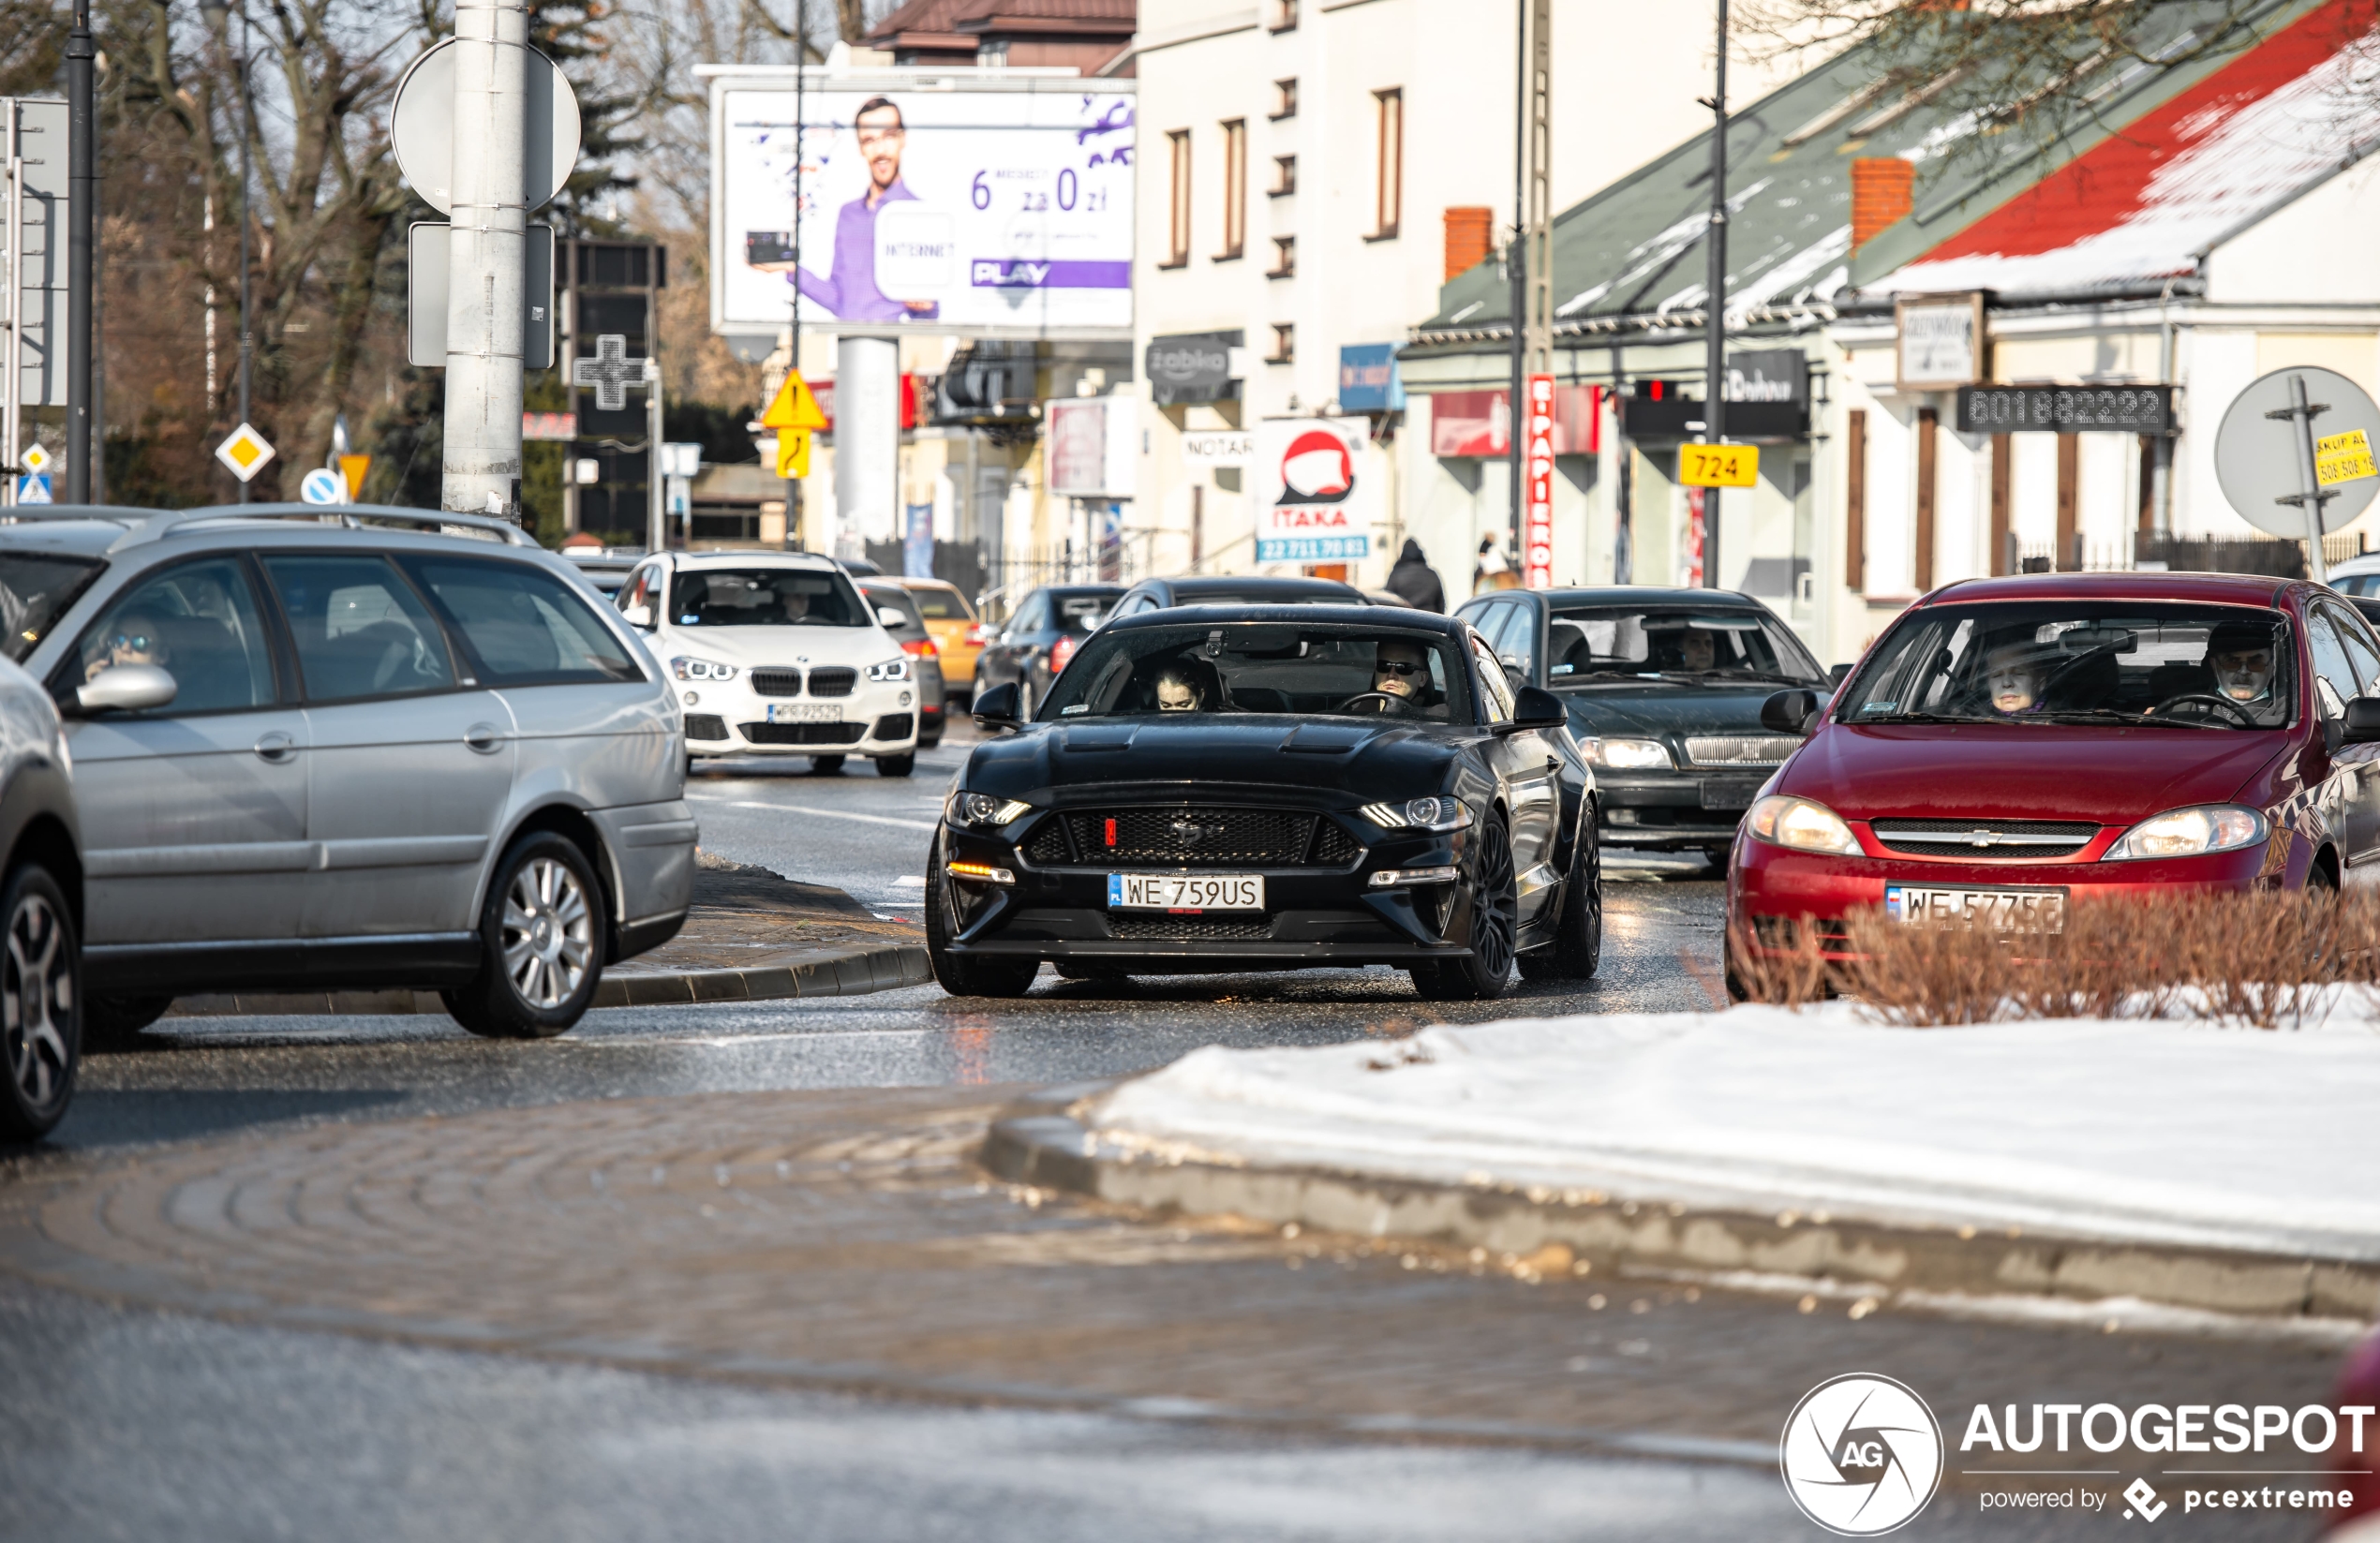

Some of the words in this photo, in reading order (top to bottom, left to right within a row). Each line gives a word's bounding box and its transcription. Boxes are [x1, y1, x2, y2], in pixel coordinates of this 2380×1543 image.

[973, 169, 990, 211] 6
[974, 261, 1051, 284] PLAY
[1695, 454, 1738, 479] 724
[1272, 510, 1347, 527] ITAKA
[1111, 893, 1121, 901] PL
[1127, 879, 1161, 904] WE
[1172, 881, 1256, 905] 759US
[1908, 891, 1951, 919] WE
